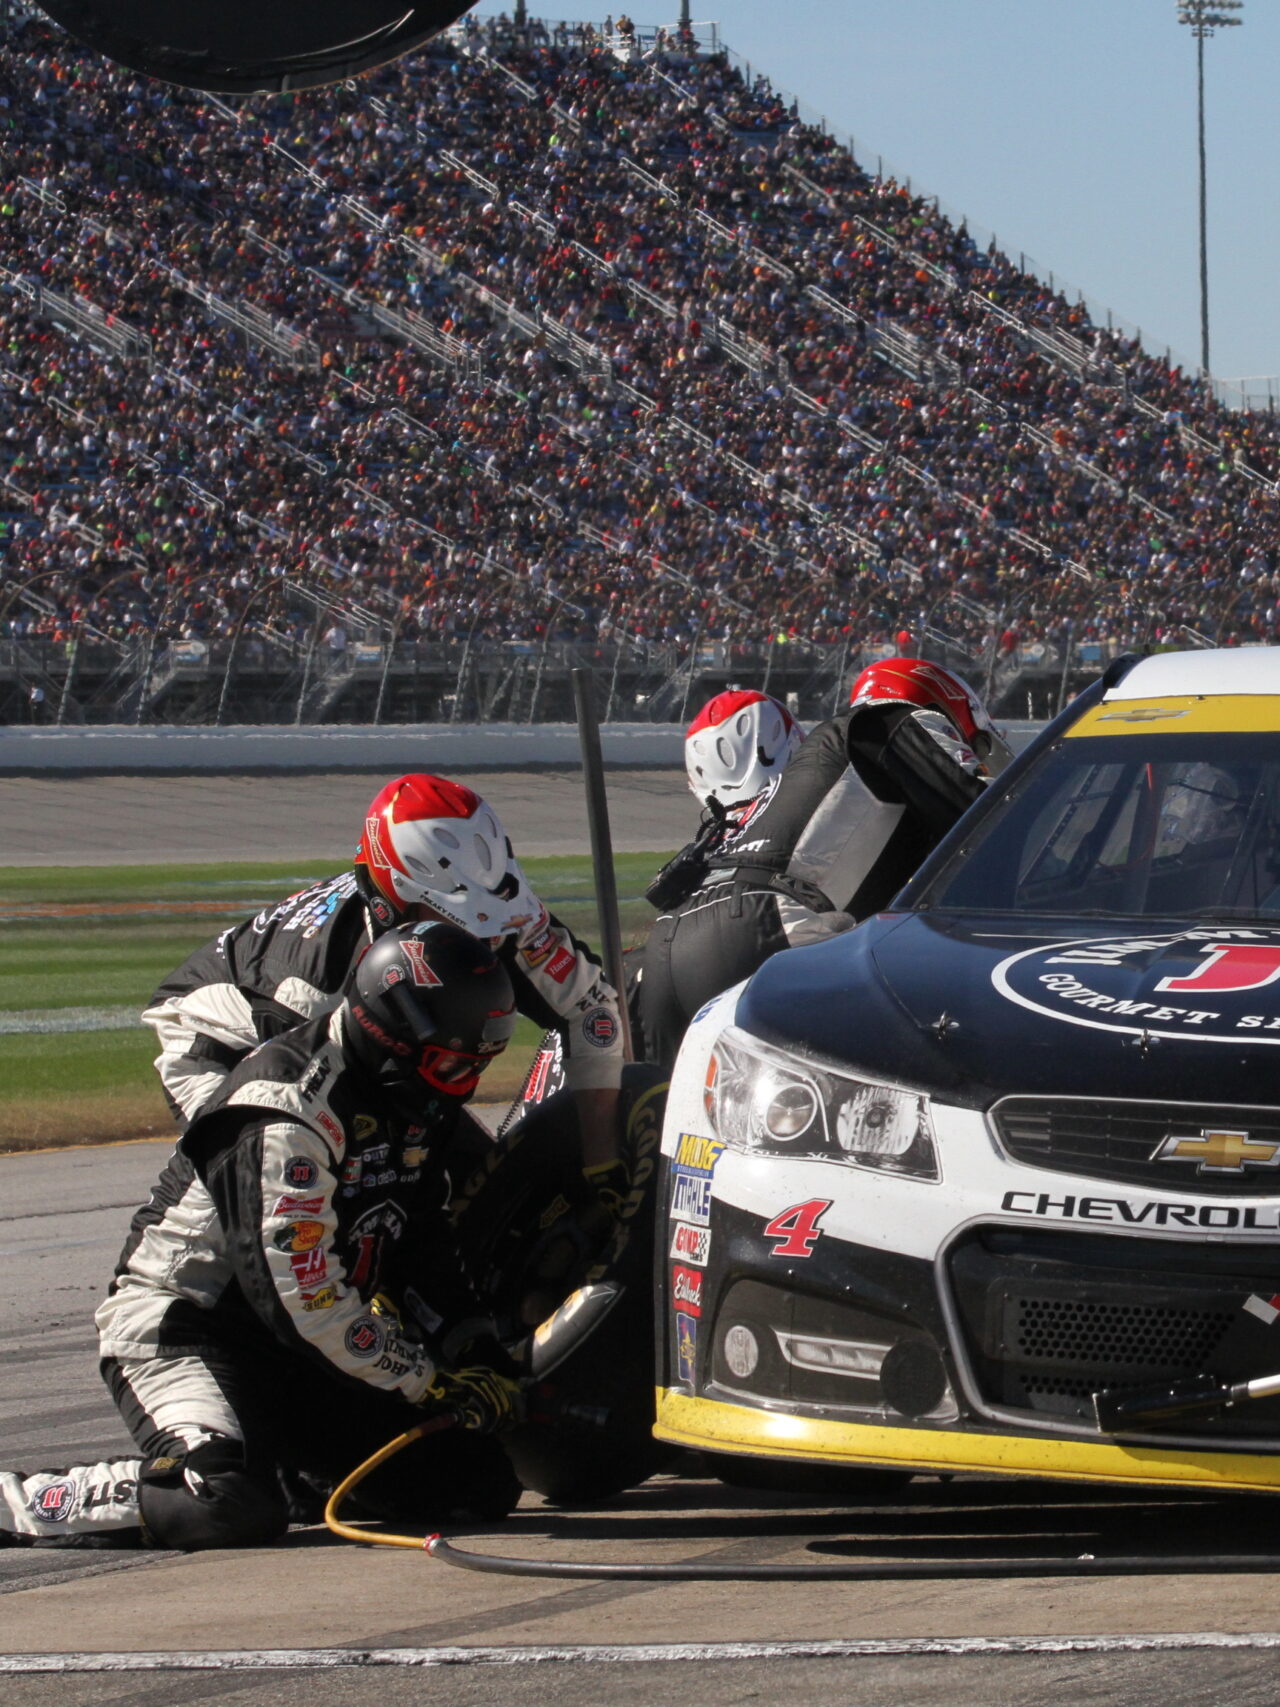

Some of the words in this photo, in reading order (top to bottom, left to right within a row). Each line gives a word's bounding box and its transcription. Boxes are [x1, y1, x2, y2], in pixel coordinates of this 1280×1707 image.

[549, 953, 573, 976] Hanes
[1038, 973, 1221, 1024] GOURMET
[675, 1134, 725, 1170] MOOG
[763, 1198, 833, 1258] 4
